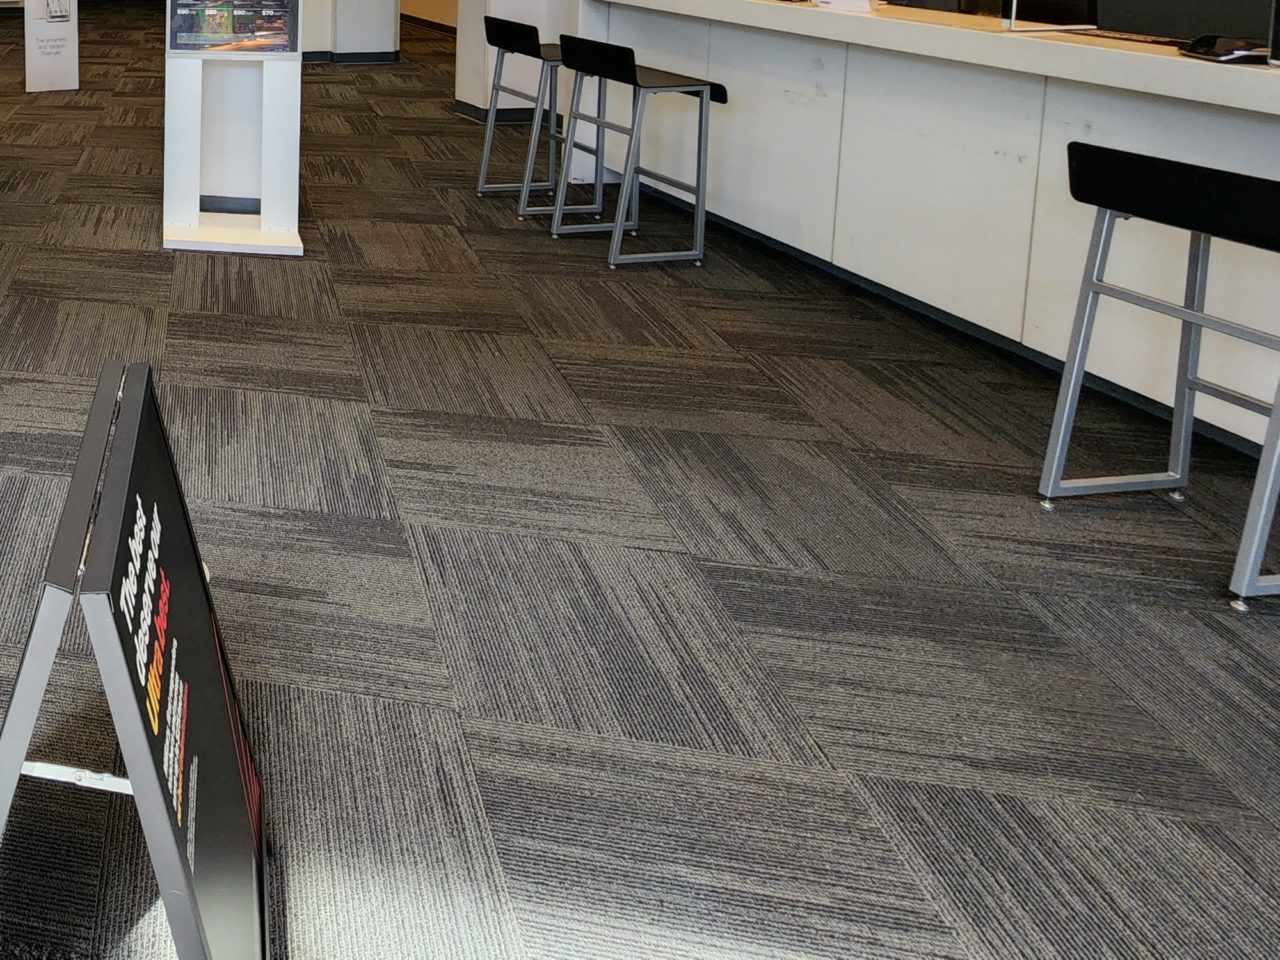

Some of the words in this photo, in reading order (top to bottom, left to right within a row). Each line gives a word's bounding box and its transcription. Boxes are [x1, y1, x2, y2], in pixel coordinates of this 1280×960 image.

[128, 493, 147, 575] best
[120, 562, 138, 634] The
[134, 549, 157, 687] deserve
[150, 501, 162, 560] our
[146, 640, 164, 736] Ultra
